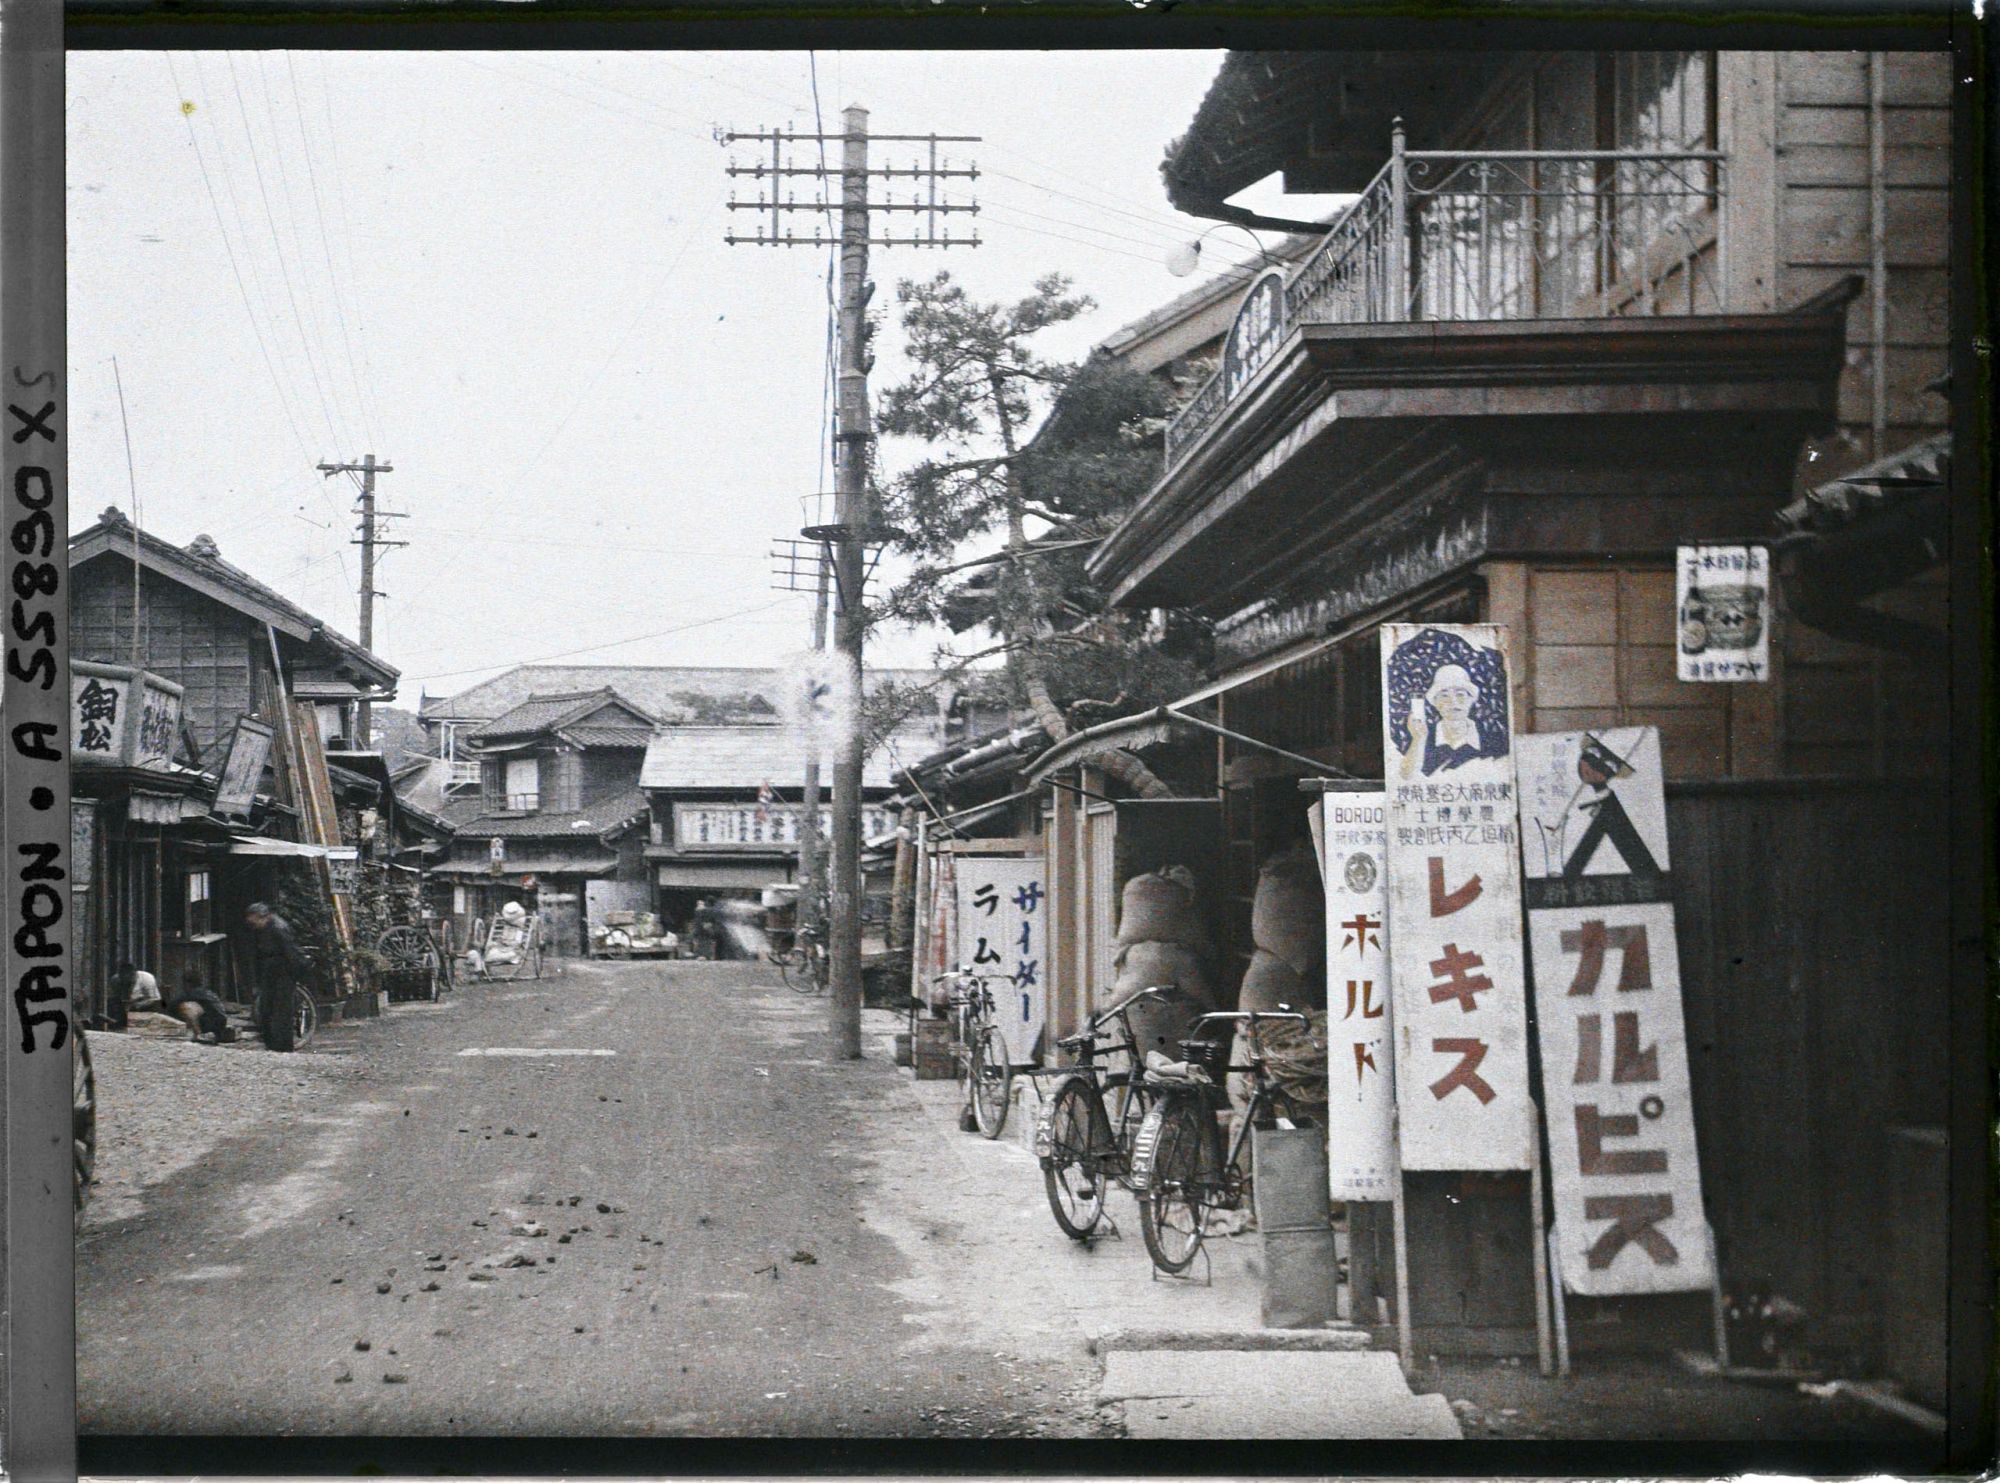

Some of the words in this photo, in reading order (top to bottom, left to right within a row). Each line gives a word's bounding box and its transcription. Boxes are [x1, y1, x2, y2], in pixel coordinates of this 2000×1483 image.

[1335, 807, 1383, 824] BORDO
[1340, 911, 1384, 1086] ボルド
[1427, 856, 1497, 1106] レキス
[1560, 920, 1679, 1271] カルピス
